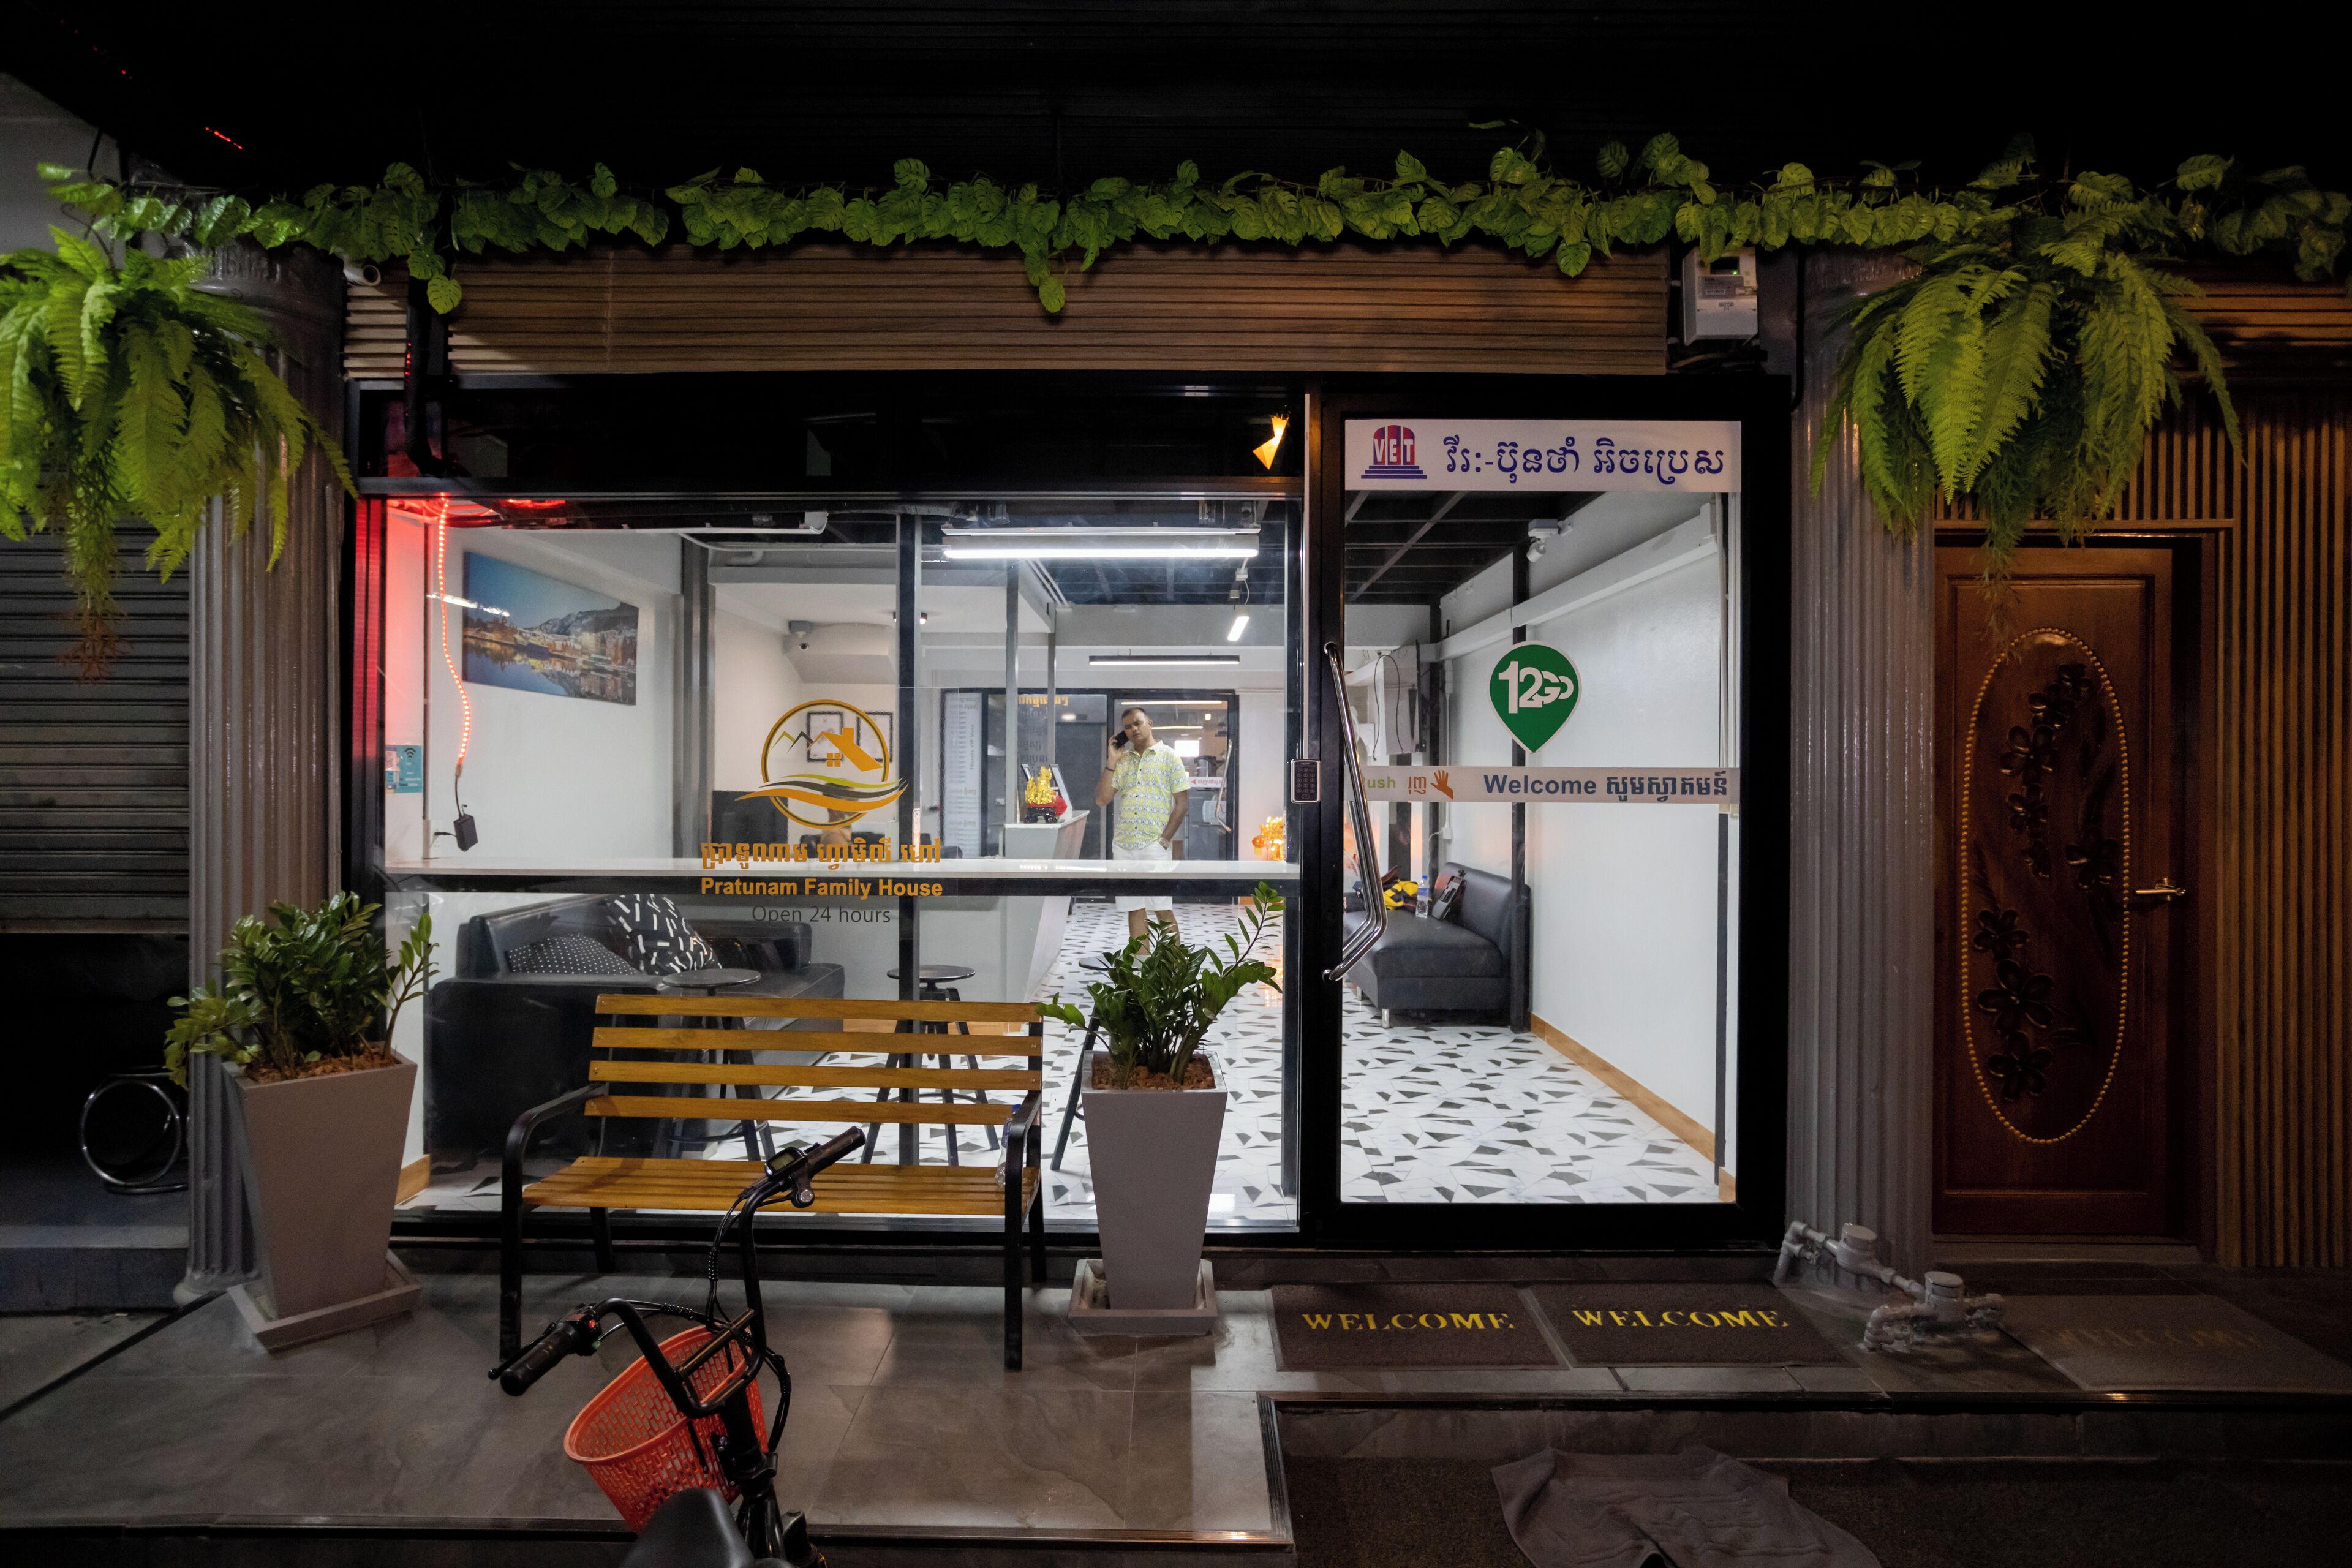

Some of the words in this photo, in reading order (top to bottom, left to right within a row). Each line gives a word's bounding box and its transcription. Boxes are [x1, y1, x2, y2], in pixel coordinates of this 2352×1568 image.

[1374, 439, 1414, 462] VET
[1362, 776, 1396, 789] ush
[1483, 774, 1597, 794] Welcome
[1607, 770, 1727, 802] សូមស្វាគមន៍
[701, 877, 797, 895] Pratunam
[805, 878, 872, 900] Family
[878, 878, 943, 897] House
[752, 906, 802, 923] Open
[809, 907, 831, 922] 24
[839, 906, 891, 923] hours
[1302, 1312, 1515, 1330] WELCOME
[1573, 1309, 1789, 1327] WELCOME
